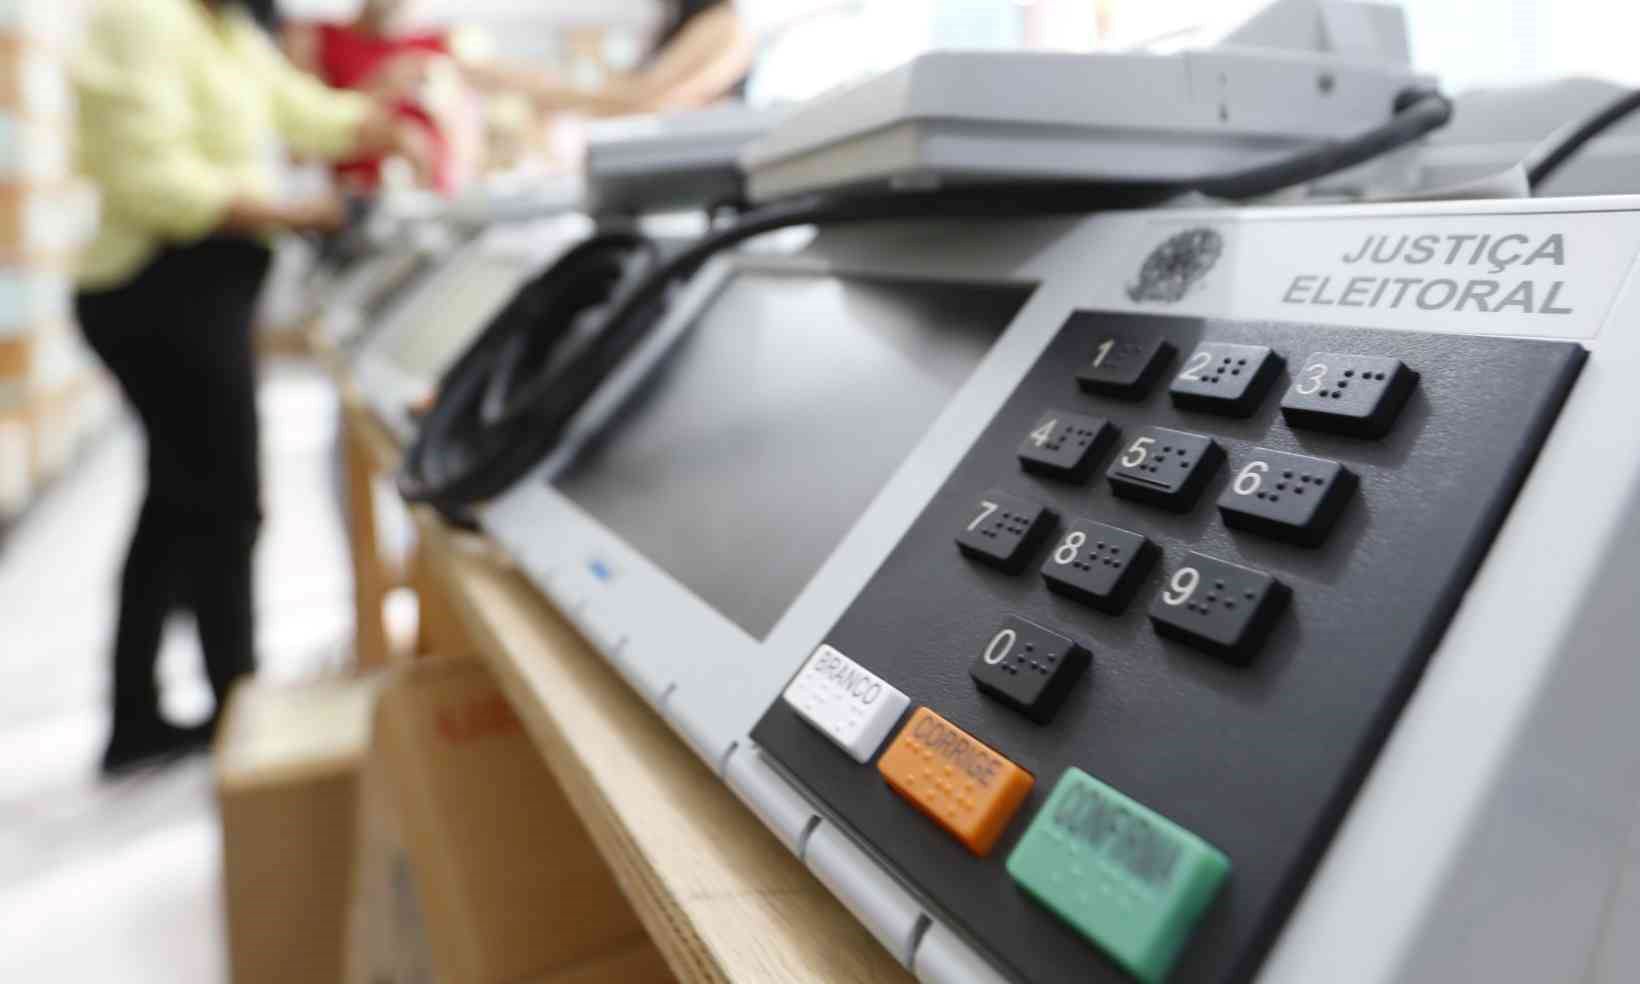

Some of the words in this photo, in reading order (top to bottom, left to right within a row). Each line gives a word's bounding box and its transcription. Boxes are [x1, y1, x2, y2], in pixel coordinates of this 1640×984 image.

[1342, 233, 1565, 274] JUSTIÇA
[1282, 274, 1573, 315] ELEITORAL
[1093, 339, 1115, 367] 1
[1179, 351, 1212, 381] 2
[1295, 363, 1328, 394] 3
[1029, 419, 1057, 447] 4
[1122, 437, 1155, 467] 5
[1233, 461, 1269, 495] 6
[967, 501, 999, 531] 7
[1054, 531, 1087, 564] 8
[1163, 567, 1199, 605] 9
[984, 629, 1016, 665] 0
[815, 650, 882, 705] BRANCO
[913, 715, 1003, 788] CORRIGE
